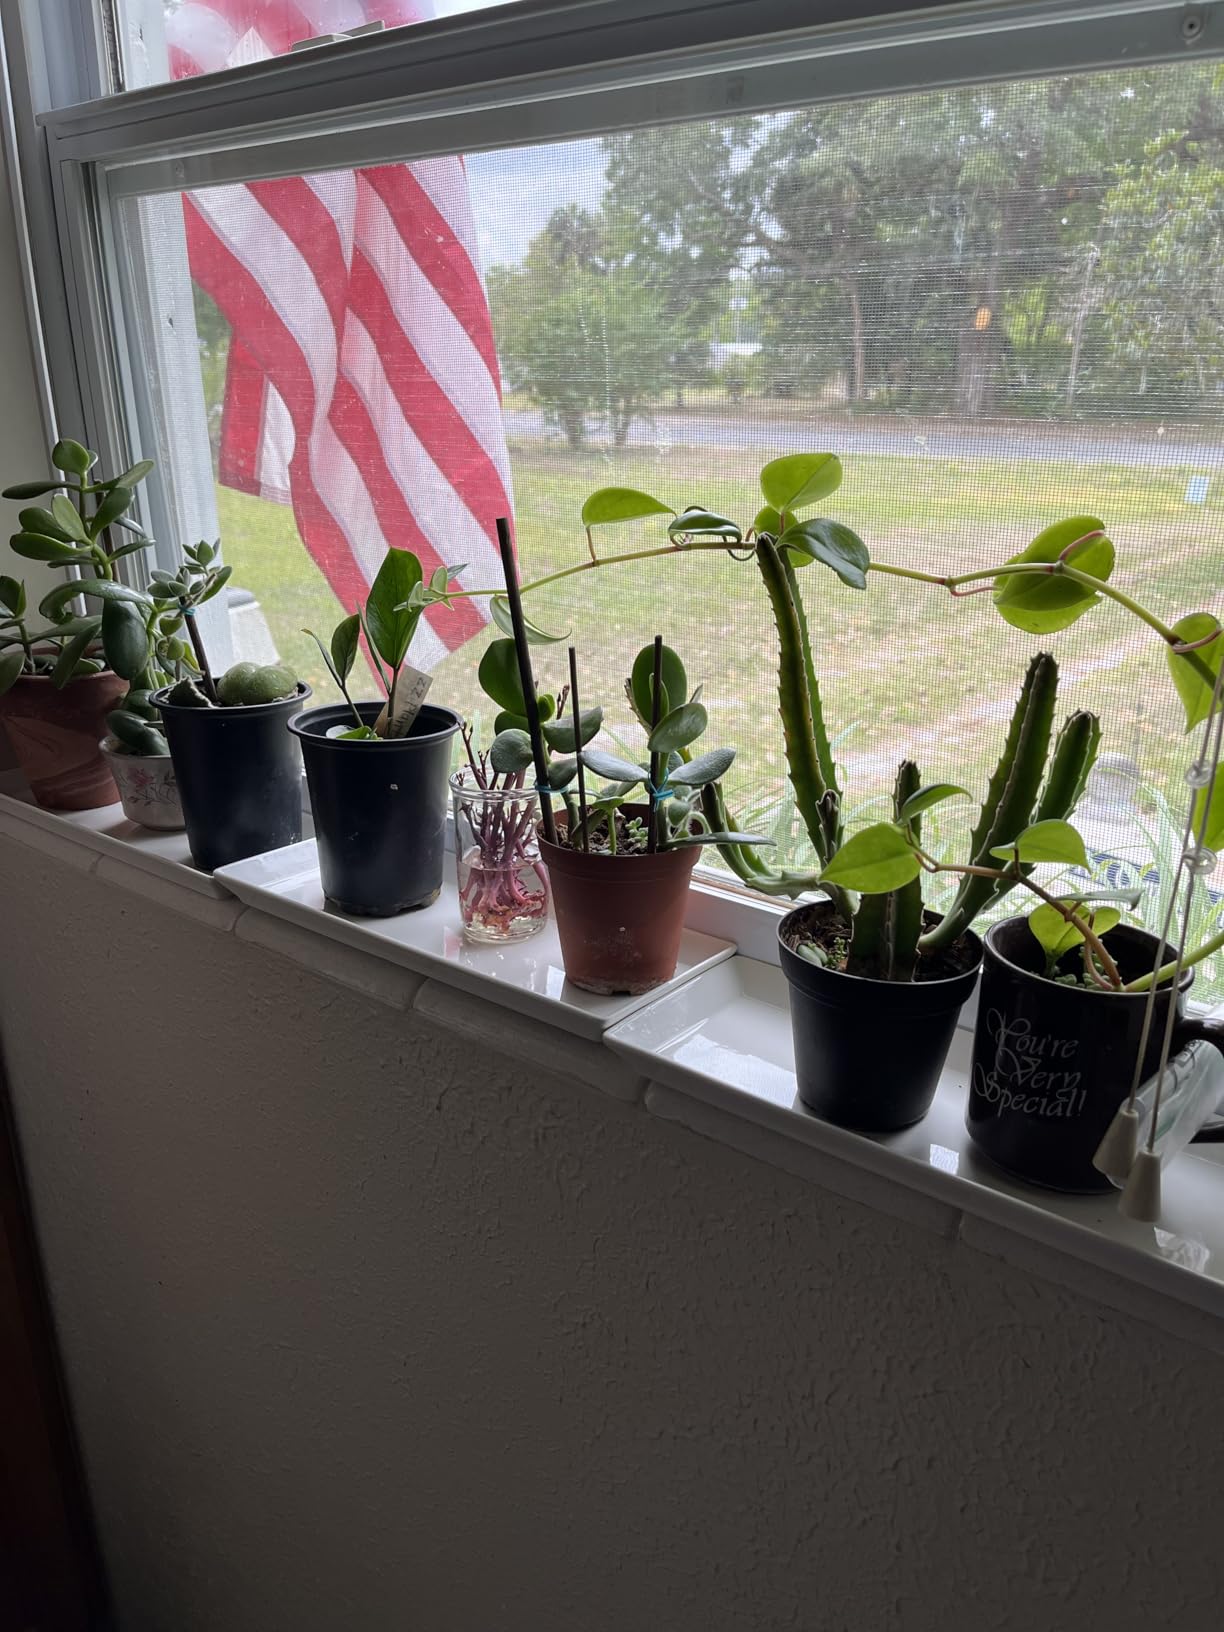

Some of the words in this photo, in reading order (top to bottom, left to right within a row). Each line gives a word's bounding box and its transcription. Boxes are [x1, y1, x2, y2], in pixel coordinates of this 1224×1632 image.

[986, 1007, 1079, 1058] You're
[973, 1062, 1087, 1117] Special!
[994, 1046, 1081, 1100] Very
